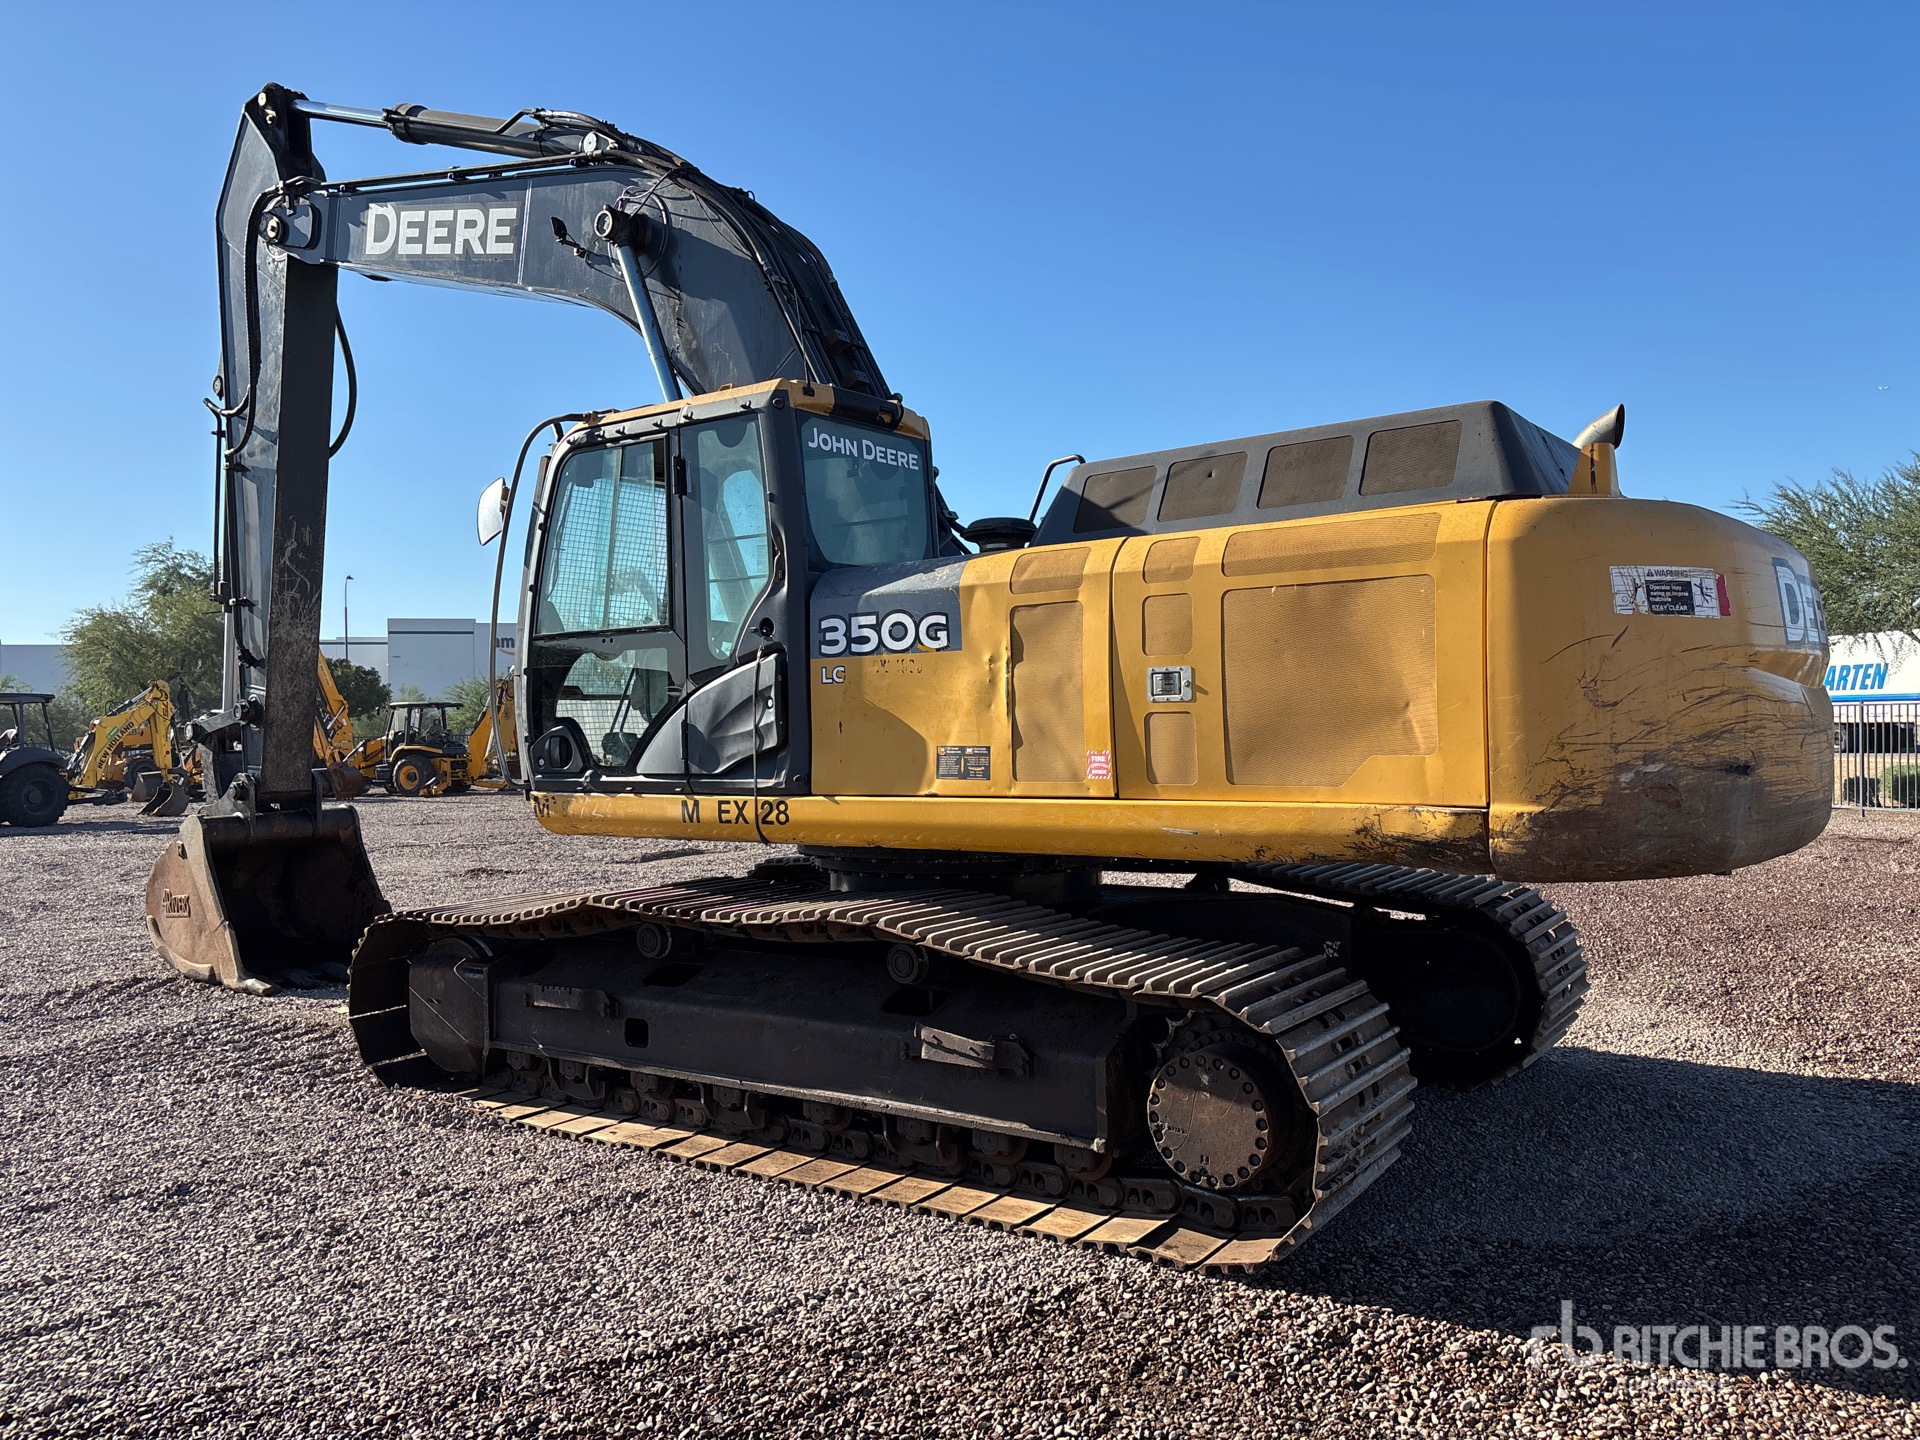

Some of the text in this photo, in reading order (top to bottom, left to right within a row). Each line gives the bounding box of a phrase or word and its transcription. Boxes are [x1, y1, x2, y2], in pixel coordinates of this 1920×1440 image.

[365, 202, 517, 255] DEERE
[808, 427, 919, 470] JOHN DEERE
[820, 612, 949, 656] 350G
[821, 666, 846, 684] LC
[97, 721, 135, 769] NEW HOLLAND
[681, 799, 701, 824] M
